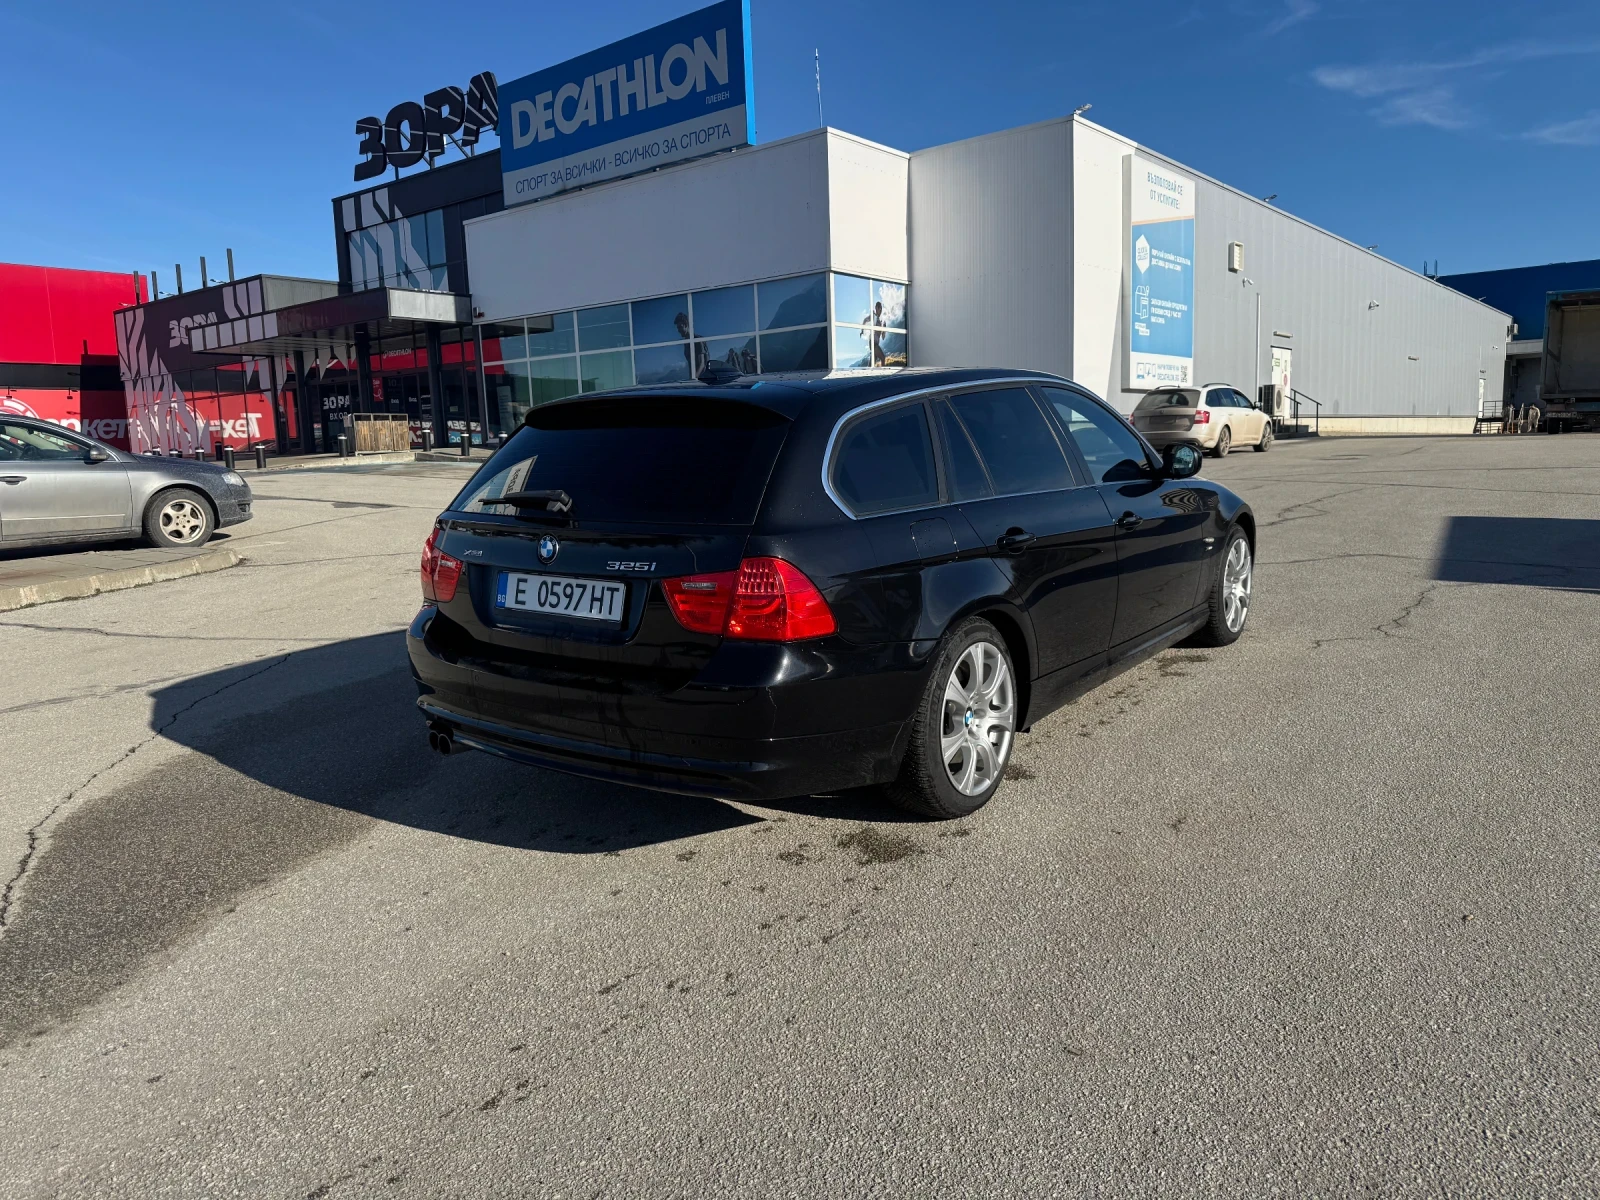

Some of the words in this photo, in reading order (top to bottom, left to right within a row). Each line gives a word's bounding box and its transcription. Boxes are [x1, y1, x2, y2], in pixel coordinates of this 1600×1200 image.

[510, 28, 729, 150] DECATHLON
[705, 90, 730, 105] ПЛЕВЕН
[354, 71, 499, 182] ЗОРА
[515, 173, 549, 194] СПОРТ
[550, 170, 564, 185] ЗА
[565, 158, 607, 182] ВСИЧКИ
[614, 142, 660, 168] ВСИЧКО
[662, 138, 679, 154] ЗА
[680, 123, 731, 149] СПОРТА
[322, 395, 350, 410] ЗОРА
[606, 561, 657, 572] 325i
[497, 594, 506, 603] BG
[514, 578, 528, 606] E
